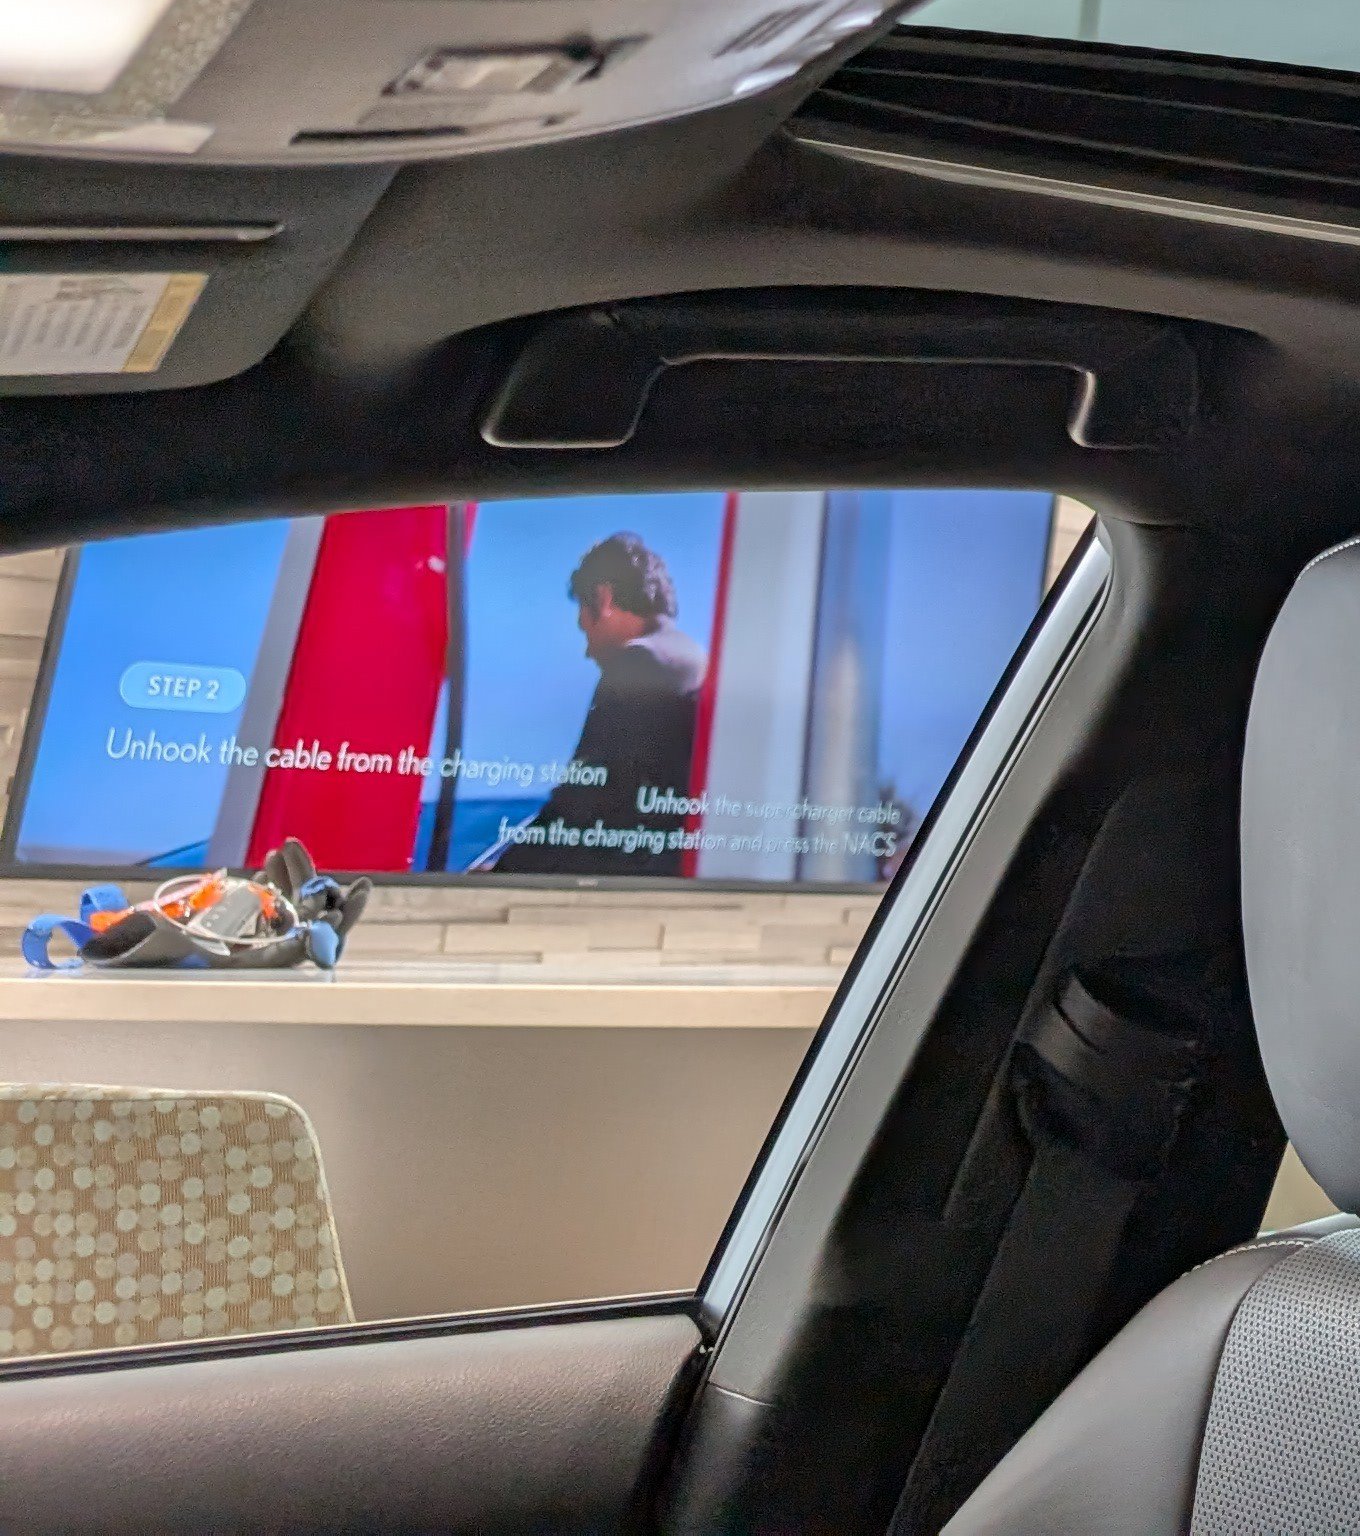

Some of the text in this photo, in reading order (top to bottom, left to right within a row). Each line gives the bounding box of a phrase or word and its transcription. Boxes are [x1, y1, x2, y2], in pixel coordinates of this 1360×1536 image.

[147, 674, 220, 701] STEP 2
[106, 726, 608, 788] Unhook the cable from the charging station
[636, 785, 709, 817] Unhook
[715, 793, 743, 818] the
[857, 798, 901, 825] cable
[499, 816, 546, 847] from
[547, 818, 579, 848] the
[582, 820, 666, 854] charging
[667, 825, 728, 852] station
[730, 830, 760, 853] and
[812, 831, 839, 855] the
[843, 830, 898, 858] NACS
